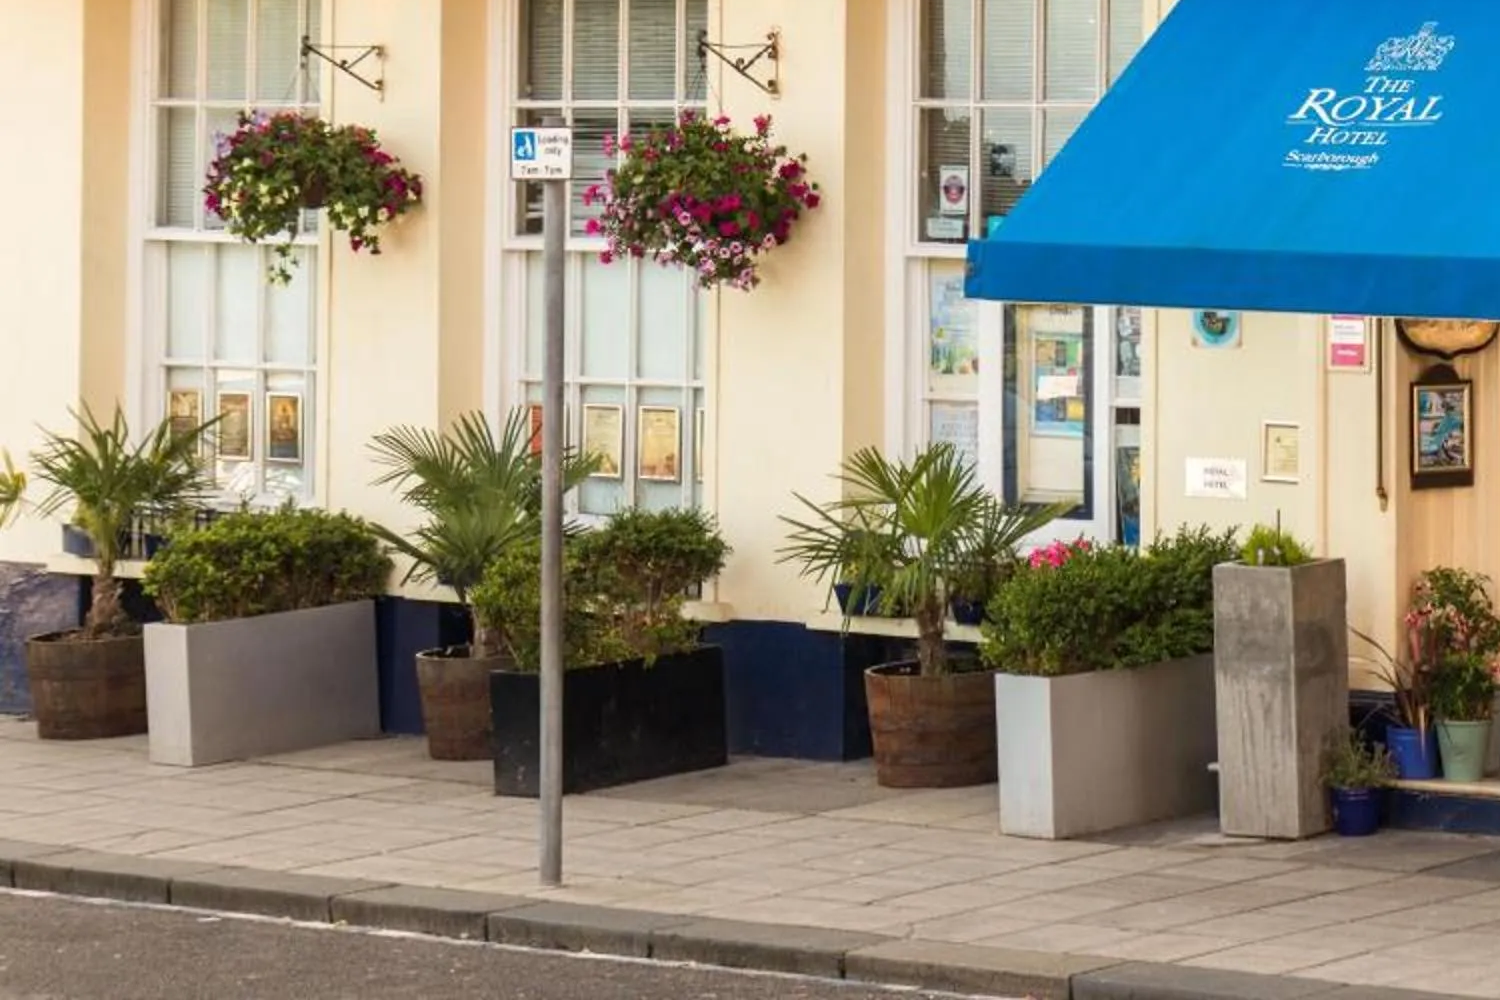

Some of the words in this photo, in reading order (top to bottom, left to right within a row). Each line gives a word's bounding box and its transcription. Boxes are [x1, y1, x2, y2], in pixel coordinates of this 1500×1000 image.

[1363, 75, 1415, 93] THE
[1287, 87, 1444, 127] ROYAL
[1303, 127, 1389, 145] HOTEL
[1285, 149, 1380, 167] Scarborough
